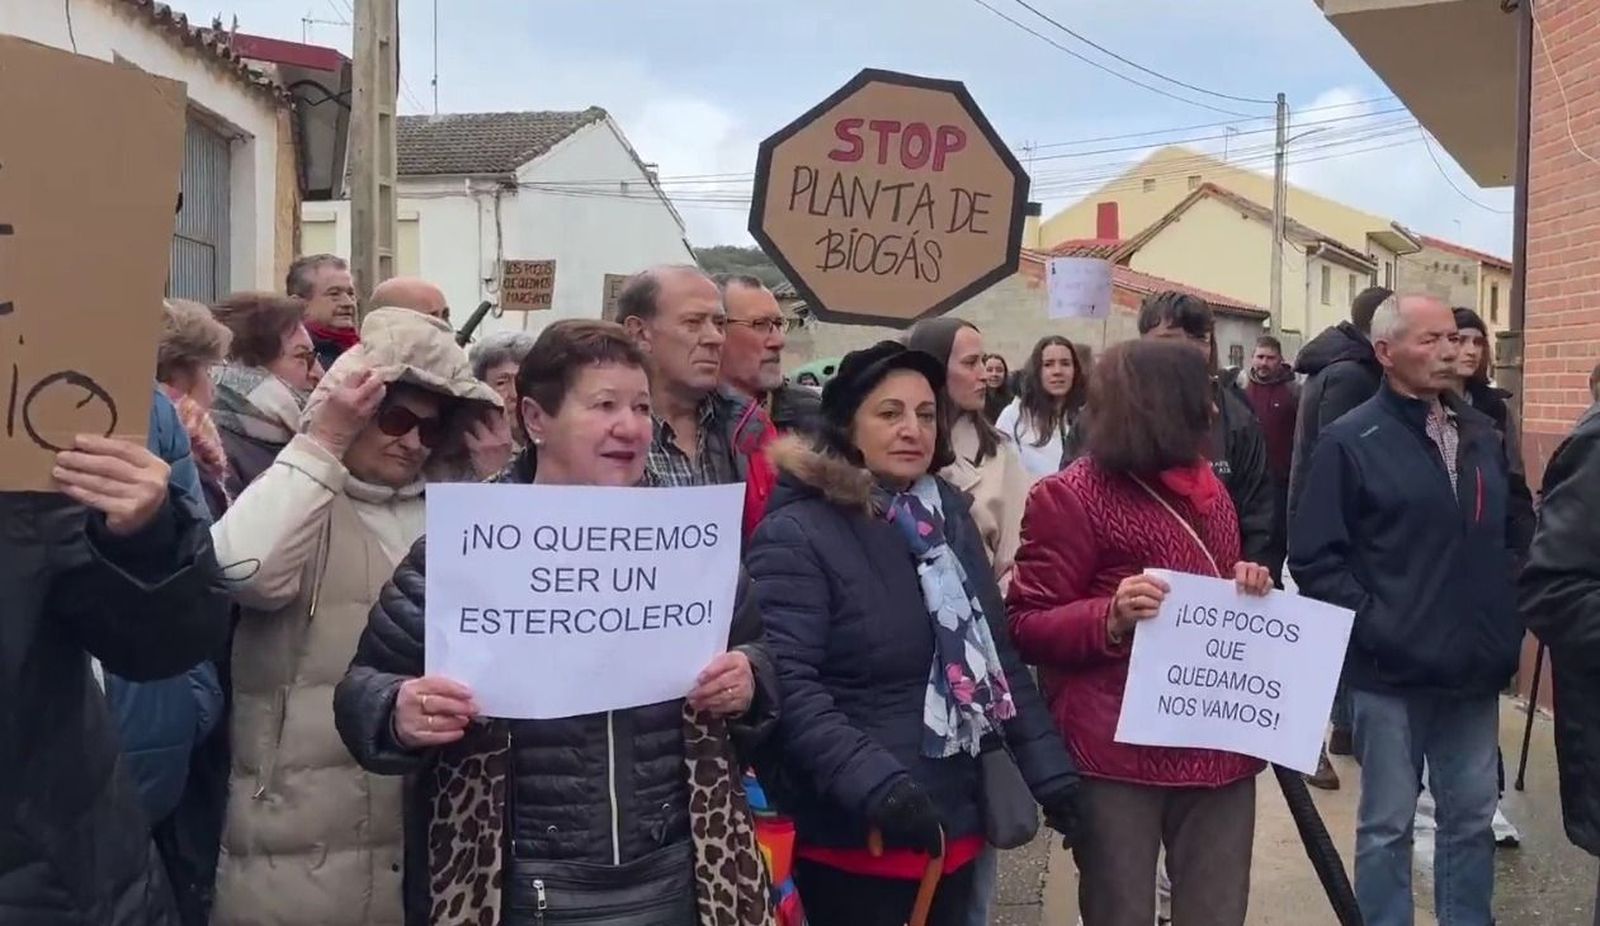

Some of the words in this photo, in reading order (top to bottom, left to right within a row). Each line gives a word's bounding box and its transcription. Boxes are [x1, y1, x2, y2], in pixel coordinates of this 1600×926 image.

[827, 118, 967, 172] STOP
[788, 165, 935, 230] PLANTA
[944, 187, 993, 234] DE
[461, 523, 522, 556] ¡NO
[533, 522, 719, 552] QUEREMOS
[530, 567, 600, 593] SER
[612, 566, 657, 592] UN
[459, 600, 713, 635] ESTERCOLERO!
[1175, 604, 1218, 628] ¡LOS
[1221, 610, 1301, 643] POCOS
[1205, 638, 1247, 661] QUE
[1167, 664, 1282, 699] QUEDAMOS
[1157, 695, 1198, 717] NOS
[1201, 699, 1280, 731] VAMOS!
